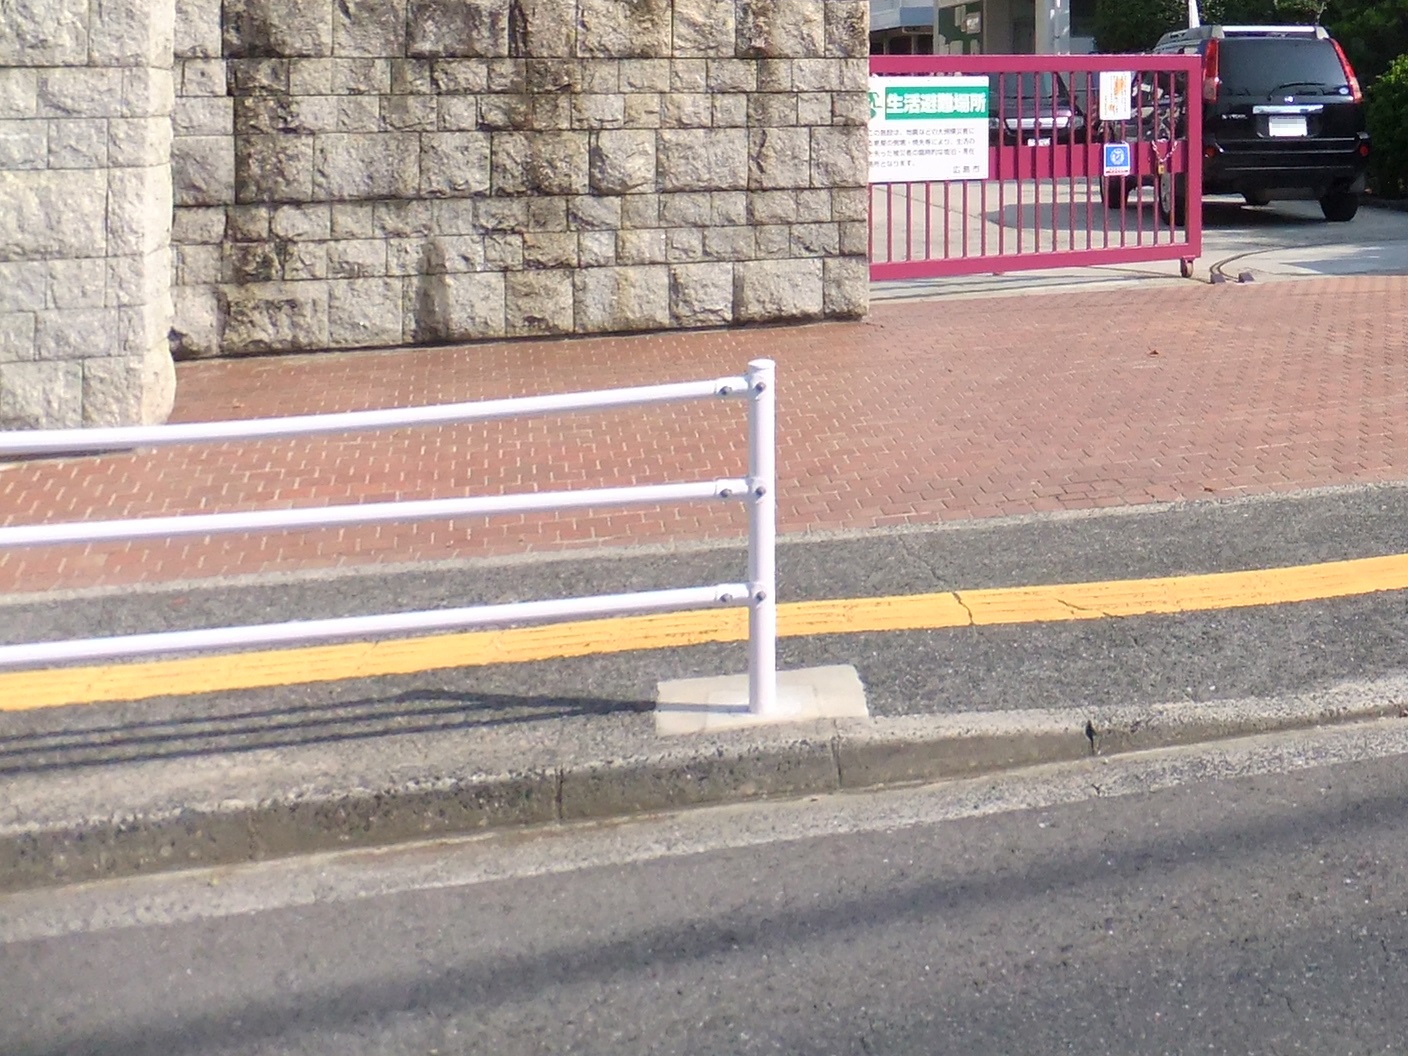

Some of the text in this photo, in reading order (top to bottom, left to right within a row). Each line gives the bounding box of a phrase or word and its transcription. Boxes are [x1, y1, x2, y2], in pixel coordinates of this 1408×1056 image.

[886, 92, 987, 114] 生活避難場所
